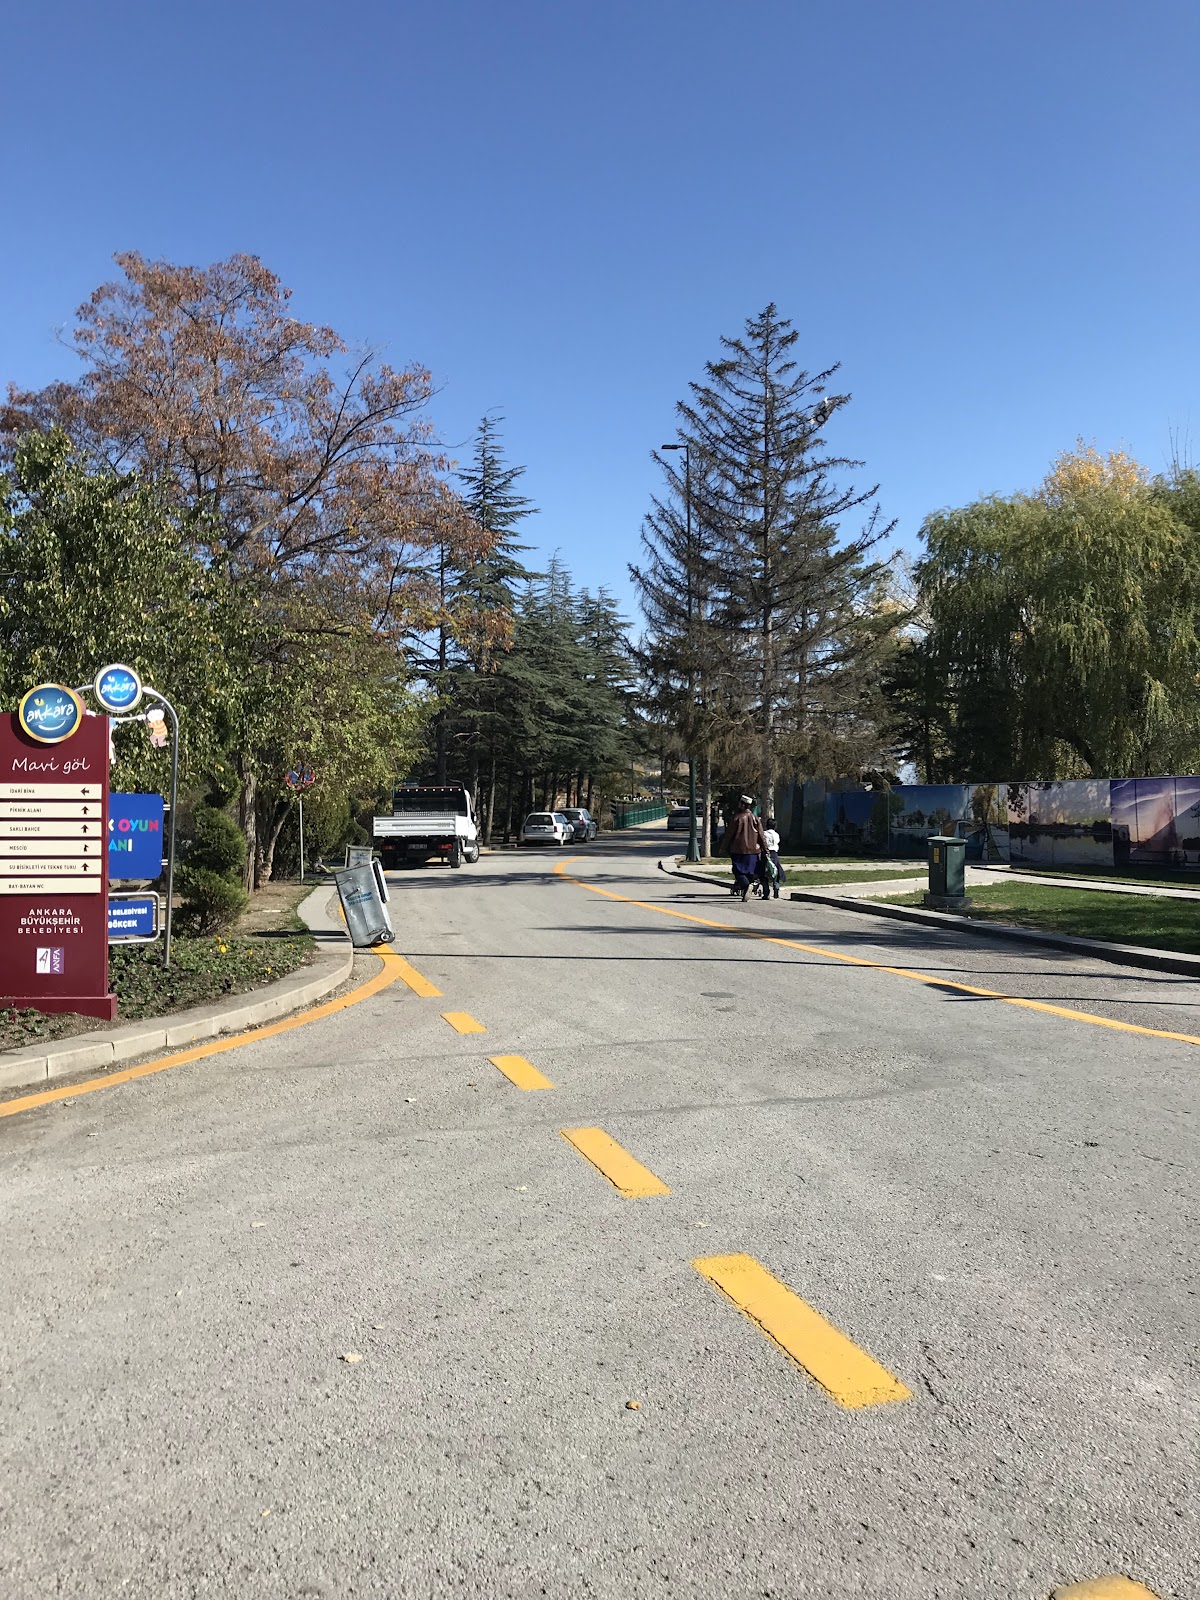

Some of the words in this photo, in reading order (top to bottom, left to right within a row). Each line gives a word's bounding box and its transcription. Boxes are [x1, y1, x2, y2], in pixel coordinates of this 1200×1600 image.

[26, 697, 75, 723] ankara
[12, 757, 59, 772] Mavi
[63, 757, 91, 775] göl
[118, 819, 158, 831] OYUN
[29, 908, 73, 916] ANKARA
[112, 907, 147, 915] BELEDİYESİ
[20, 916, 81, 926] BÜYÜKŞEHİR
[17, 926, 84, 934] BELEDİYESİ
